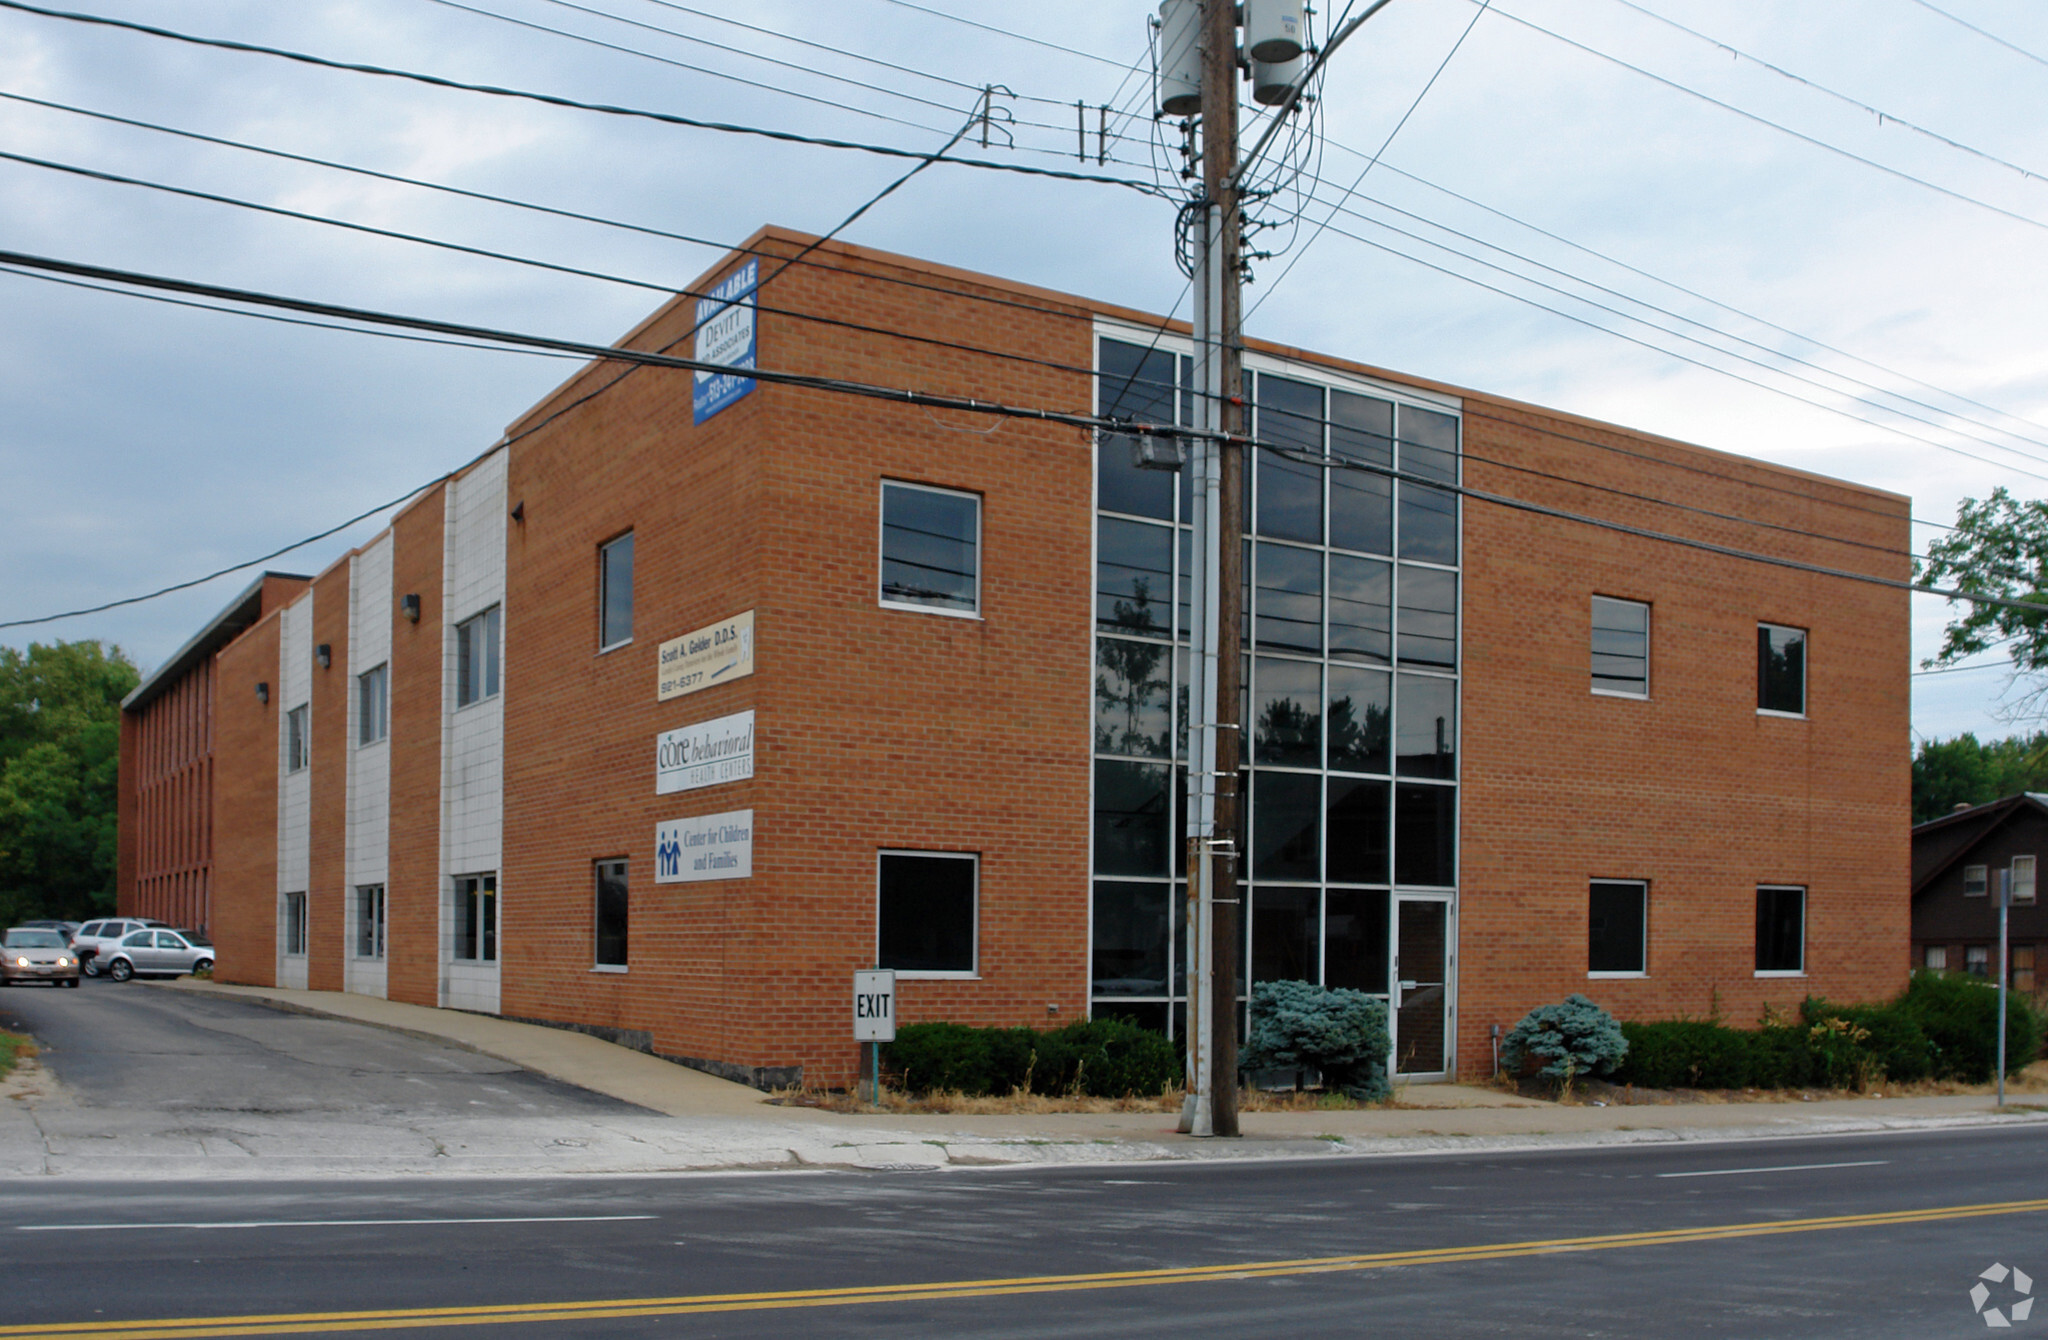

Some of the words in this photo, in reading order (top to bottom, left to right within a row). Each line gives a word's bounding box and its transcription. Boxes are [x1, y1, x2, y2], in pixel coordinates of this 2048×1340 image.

[696, 261, 757, 324] AVAILABLE
[661, 646, 678, 665] Scott
[691, 723, 752, 762] behavioral
[684, 830, 706, 848] Center
[707, 827, 718, 845] for
[719, 824, 749, 844] Children
[694, 852, 707, 871] and
[708, 850, 738, 870] Families
[857, 993, 891, 1018] EXIT
